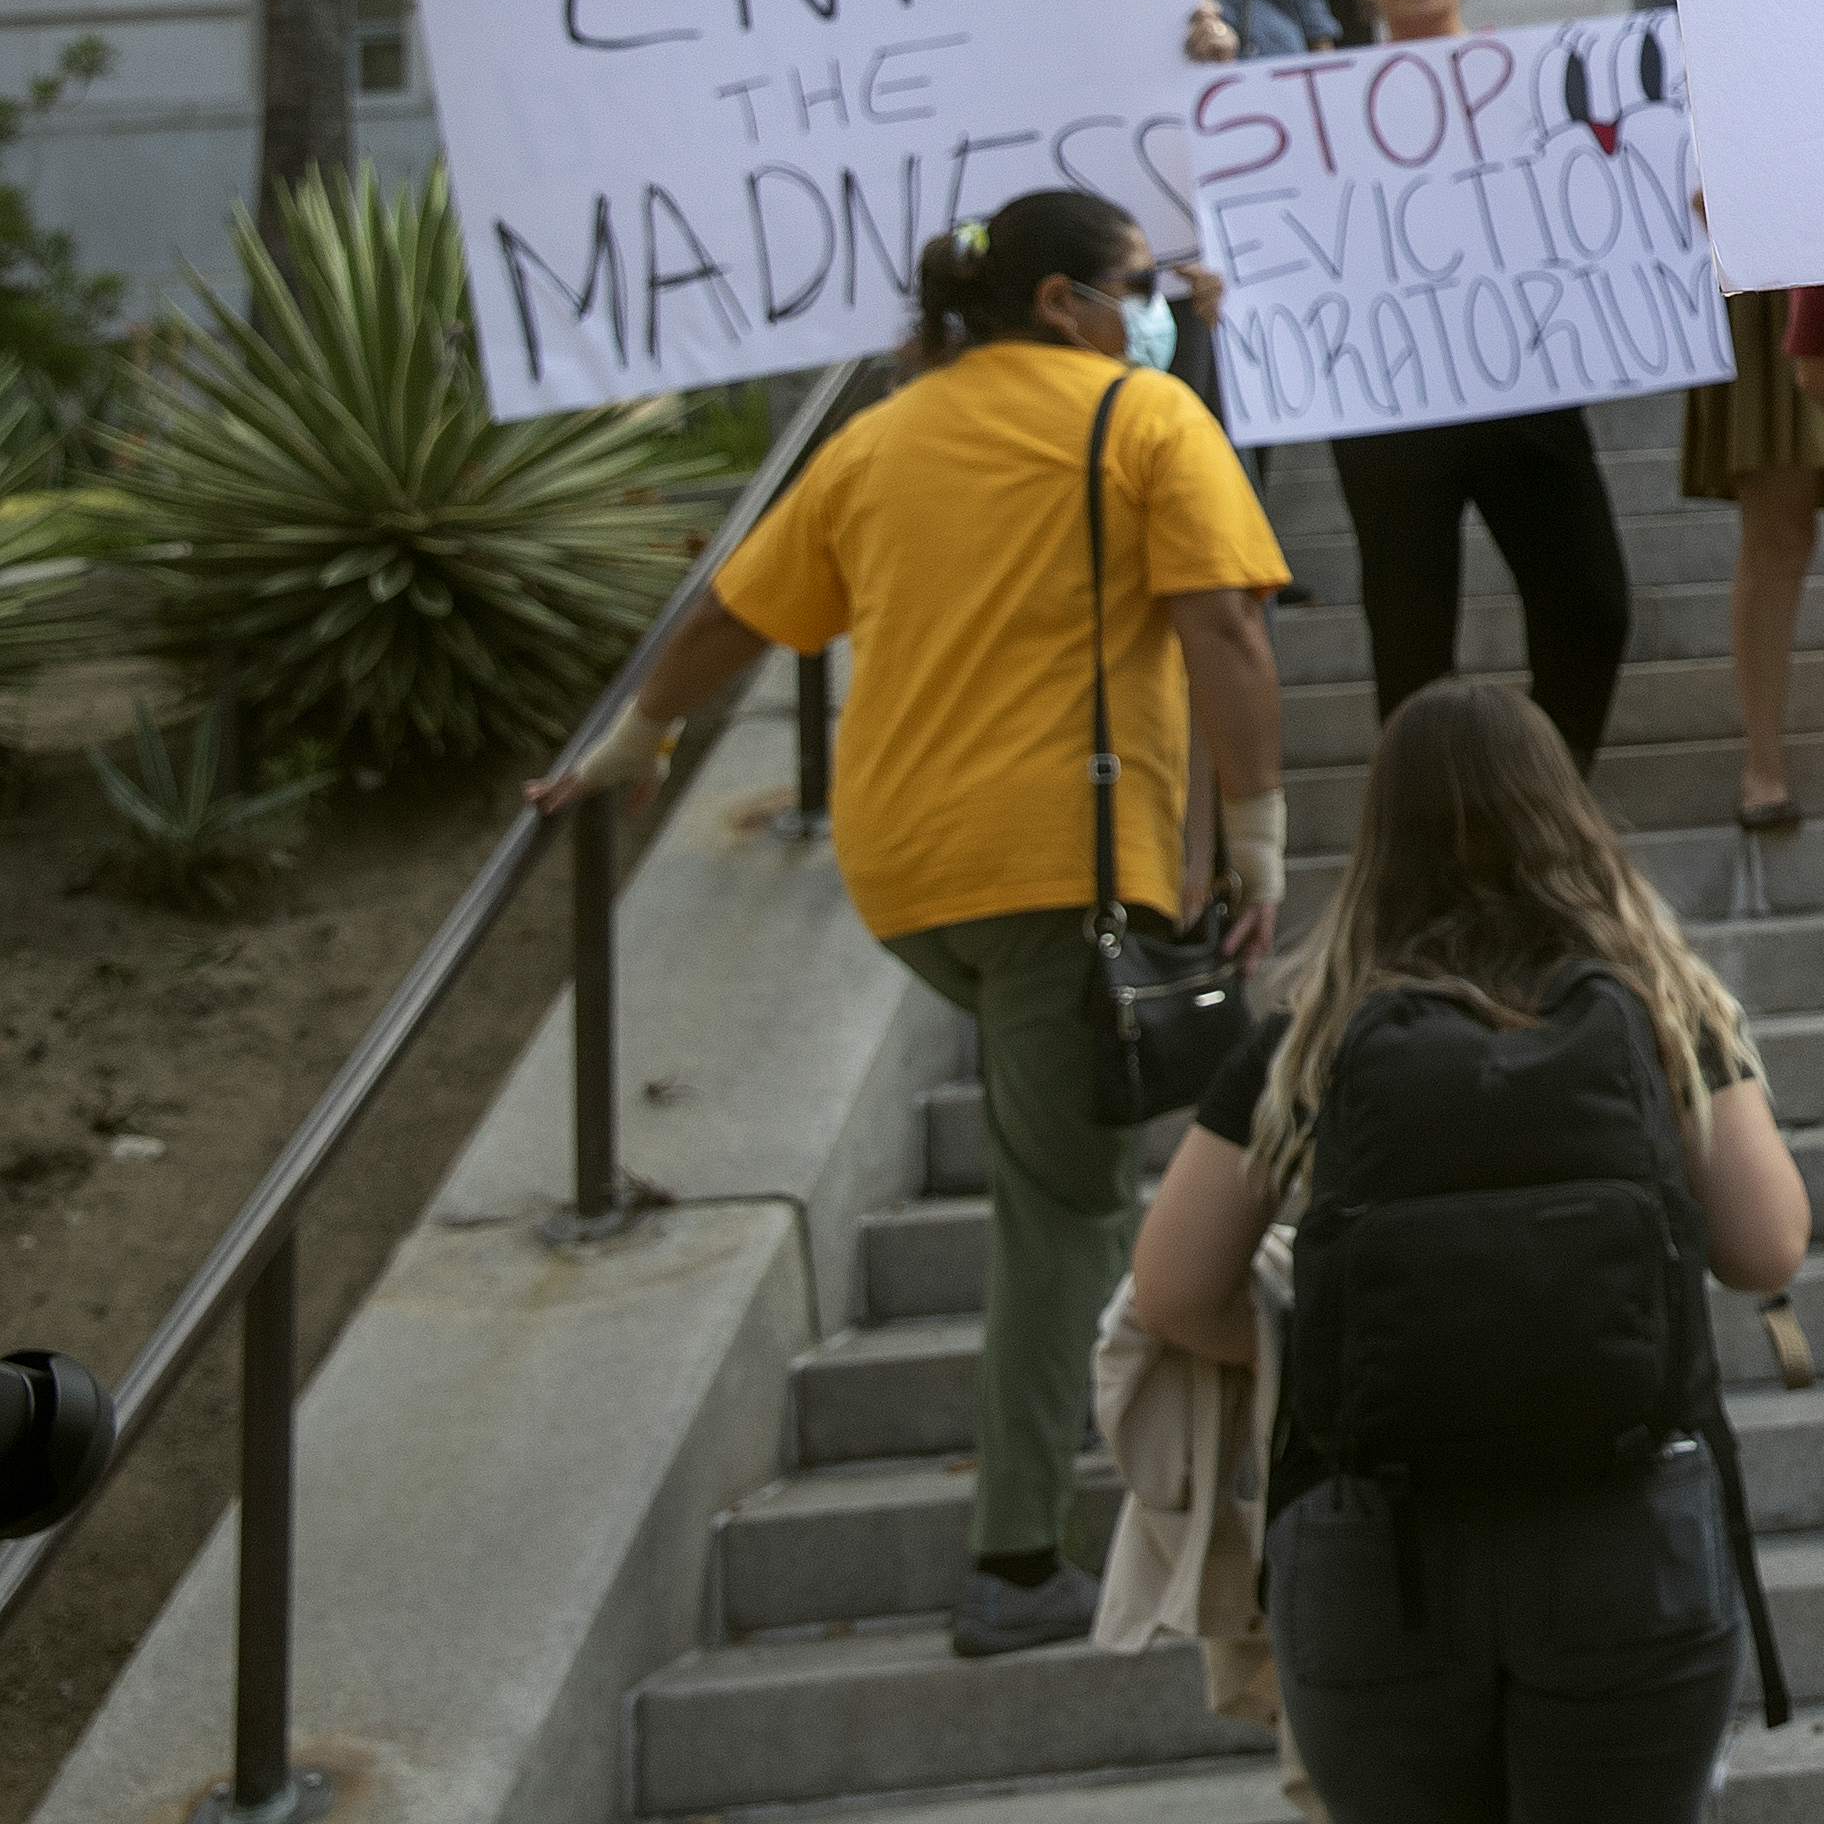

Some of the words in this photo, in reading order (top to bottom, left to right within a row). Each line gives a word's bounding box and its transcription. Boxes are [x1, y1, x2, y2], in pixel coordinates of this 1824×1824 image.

[716, 32, 972, 143] THE
[1196, 40, 1516, 186] STOP
[1213, 140, 1694, 286] EVICTION
[1219, 253, 1735, 422] MORATORIUM
